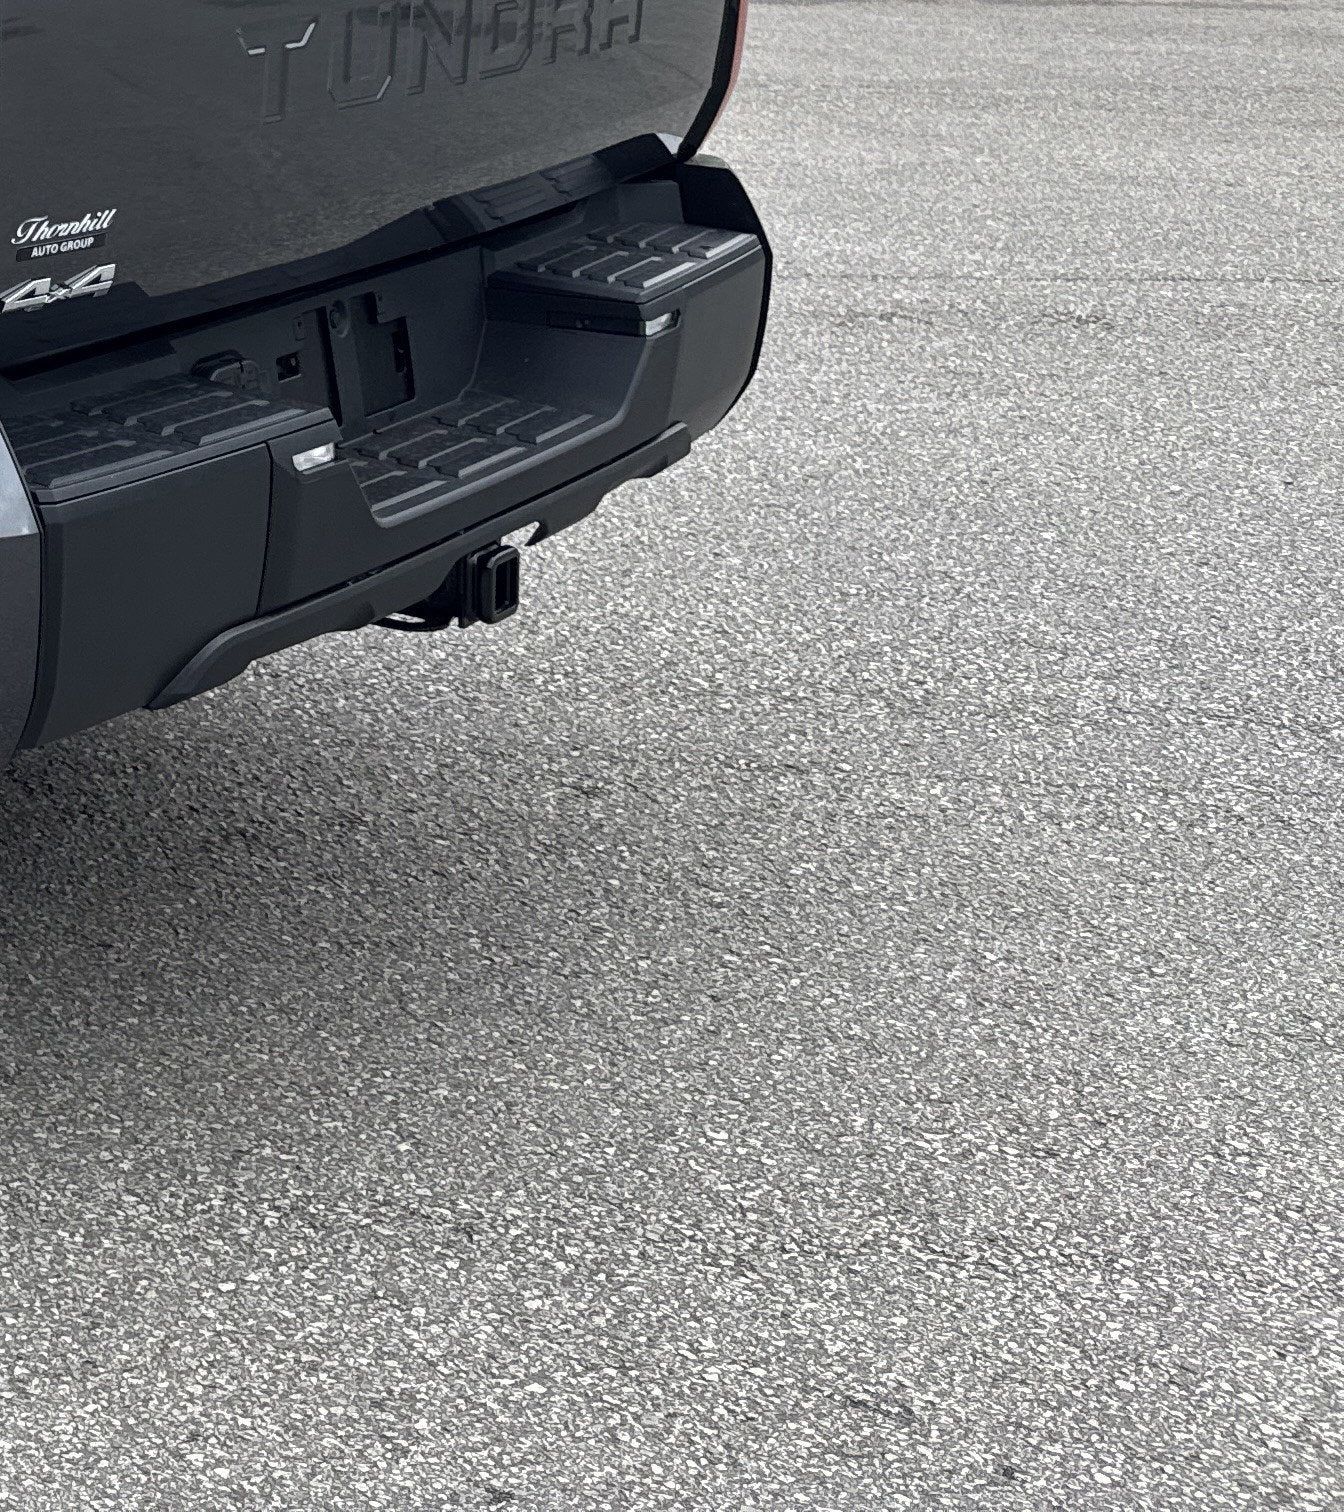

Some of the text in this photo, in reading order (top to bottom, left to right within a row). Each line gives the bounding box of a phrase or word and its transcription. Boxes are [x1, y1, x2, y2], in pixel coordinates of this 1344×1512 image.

[10, 208, 118, 245] Thornhill
[30, 237, 94, 258] AUTO GROUP
